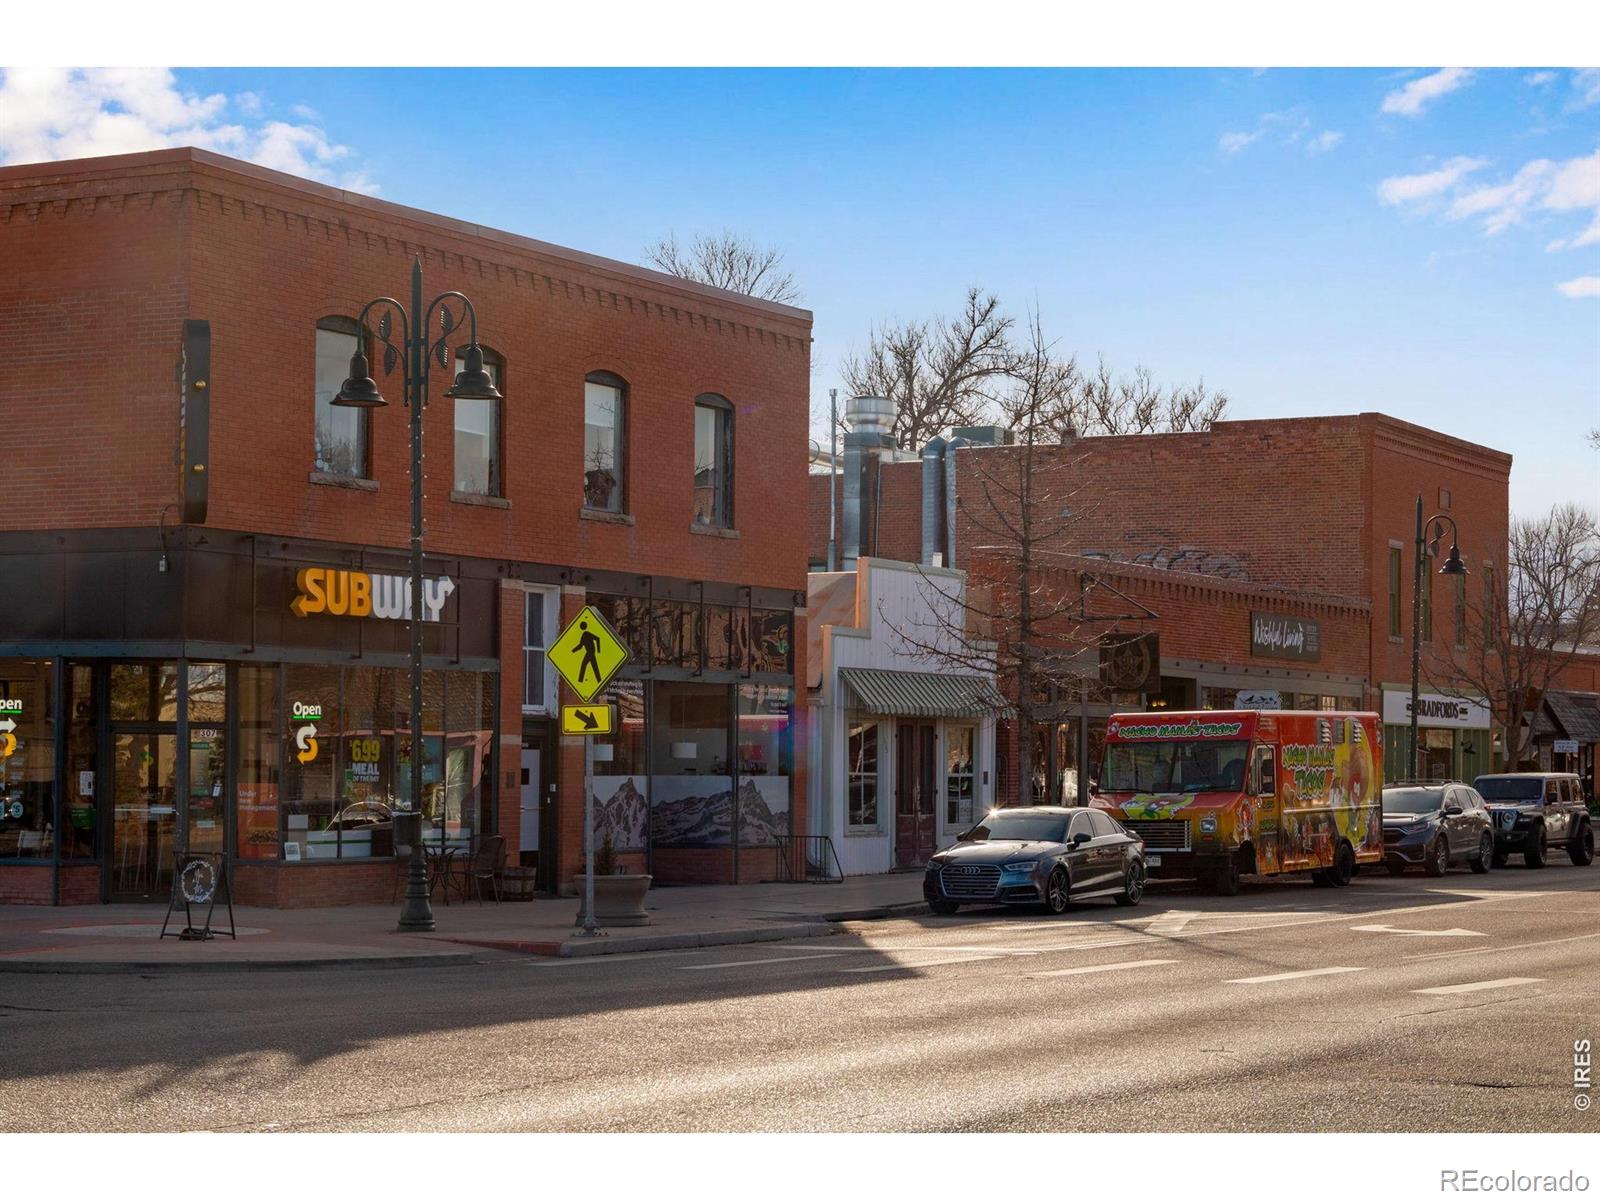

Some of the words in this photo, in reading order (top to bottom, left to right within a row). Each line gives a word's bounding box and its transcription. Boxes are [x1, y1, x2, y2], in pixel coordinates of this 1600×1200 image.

[0, 699, 22, 713] pen
[293, 701, 322, 718] Open
[352, 763, 380, 775] MEAL
